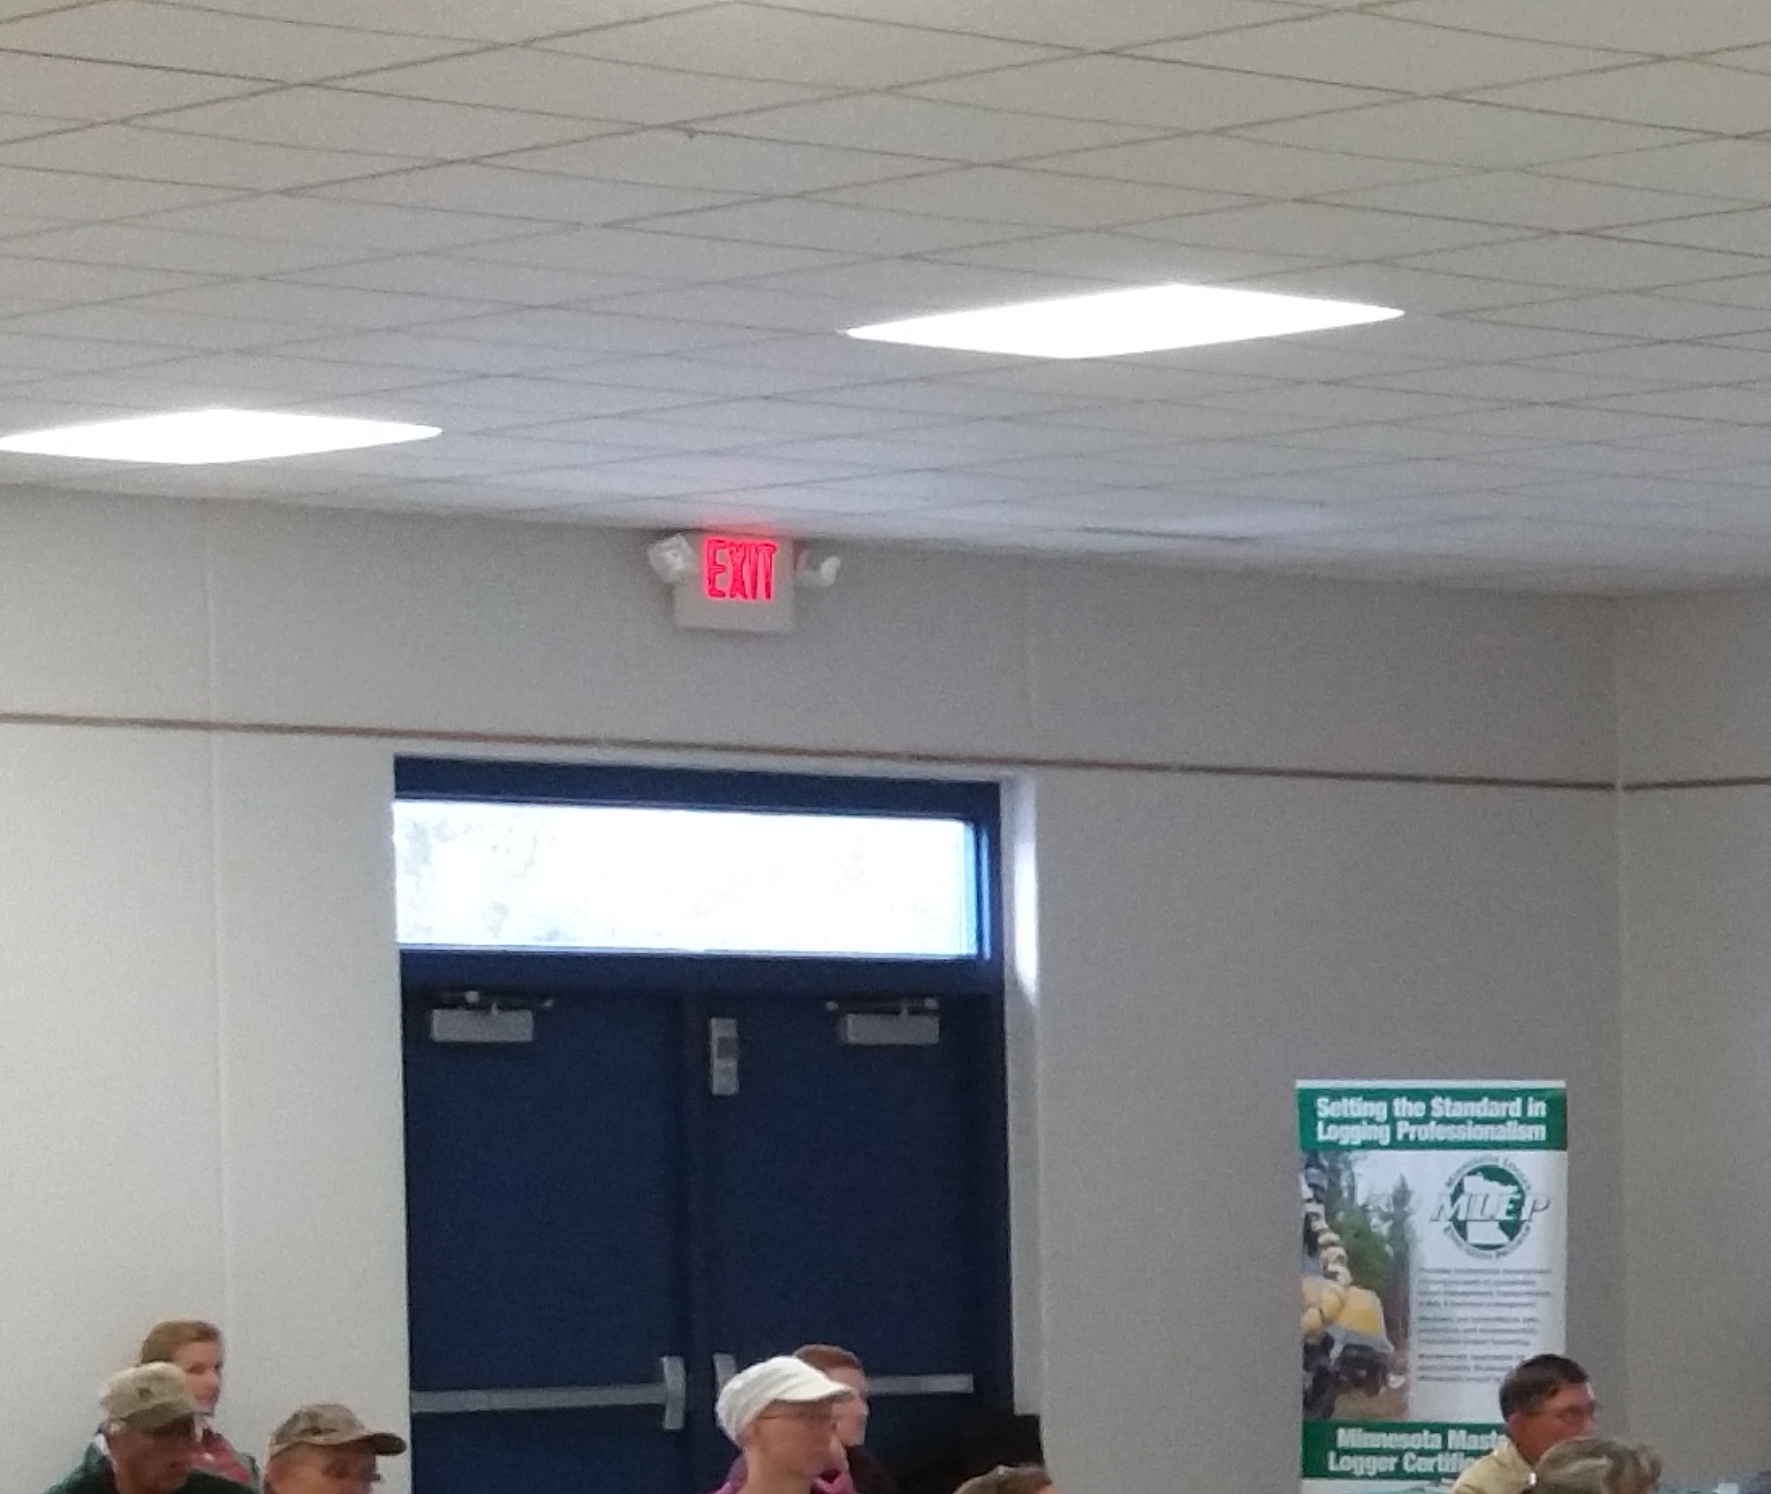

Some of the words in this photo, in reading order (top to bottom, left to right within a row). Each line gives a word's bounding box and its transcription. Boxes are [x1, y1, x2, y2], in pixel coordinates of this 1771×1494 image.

[704, 537, 777, 600] EXIT
[1316, 1097, 1388, 1121] Setting
[1392, 1097, 1426, 1118] the
[1431, 1096, 1522, 1118] Standard
[1527, 1097, 1547, 1117] in
[1317, 1121, 1390, 1146] Logging
[1396, 1121, 1547, 1141] Professionalism
[1336, 1428, 1442, 1449] Minnesota
[1328, 1451, 1398, 1477] Logger
